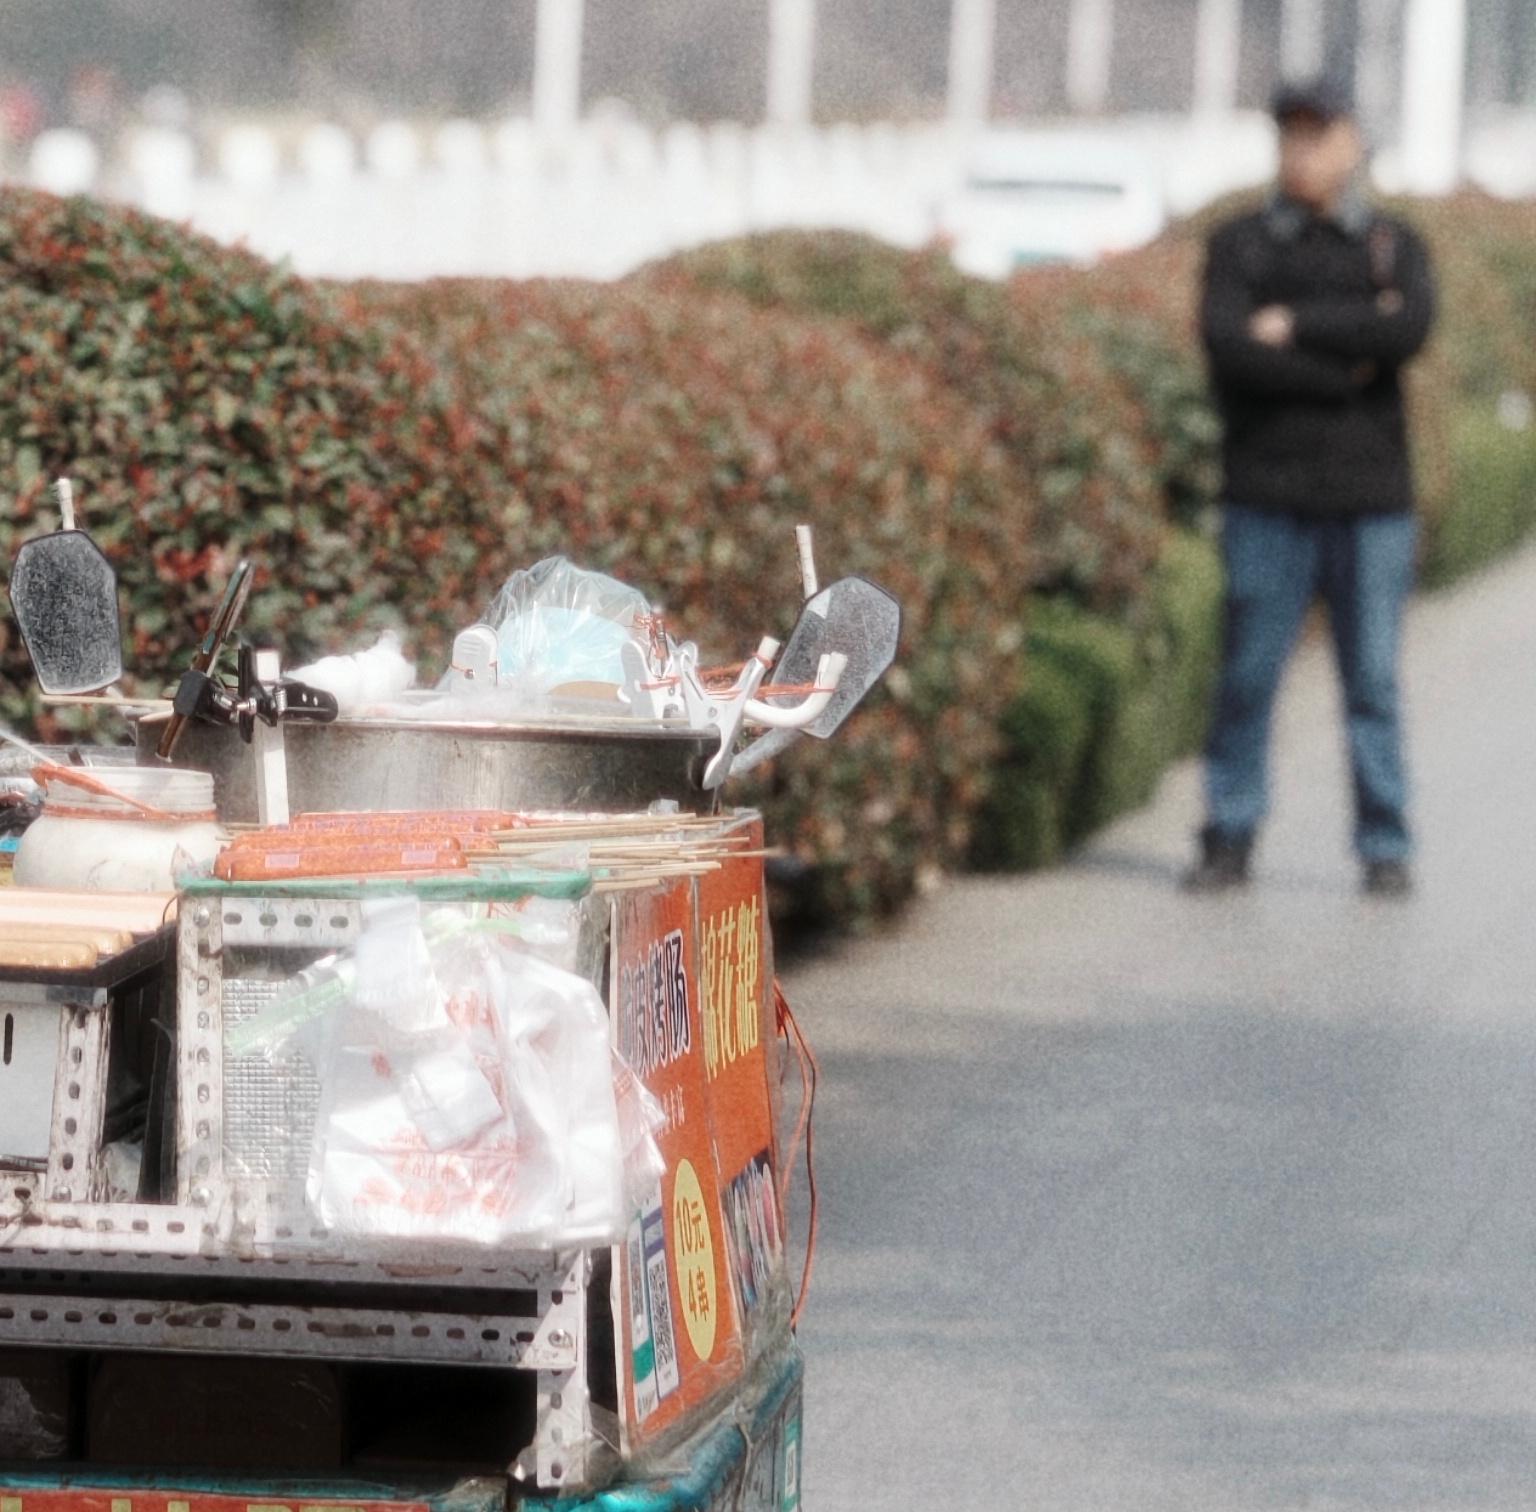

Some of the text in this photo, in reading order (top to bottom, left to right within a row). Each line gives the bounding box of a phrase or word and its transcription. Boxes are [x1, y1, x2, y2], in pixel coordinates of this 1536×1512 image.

[701, 895, 760, 1082] 棉花糖
[675, 1197, 704, 1257] 10元
[688, 1266, 709, 1324] 4串
